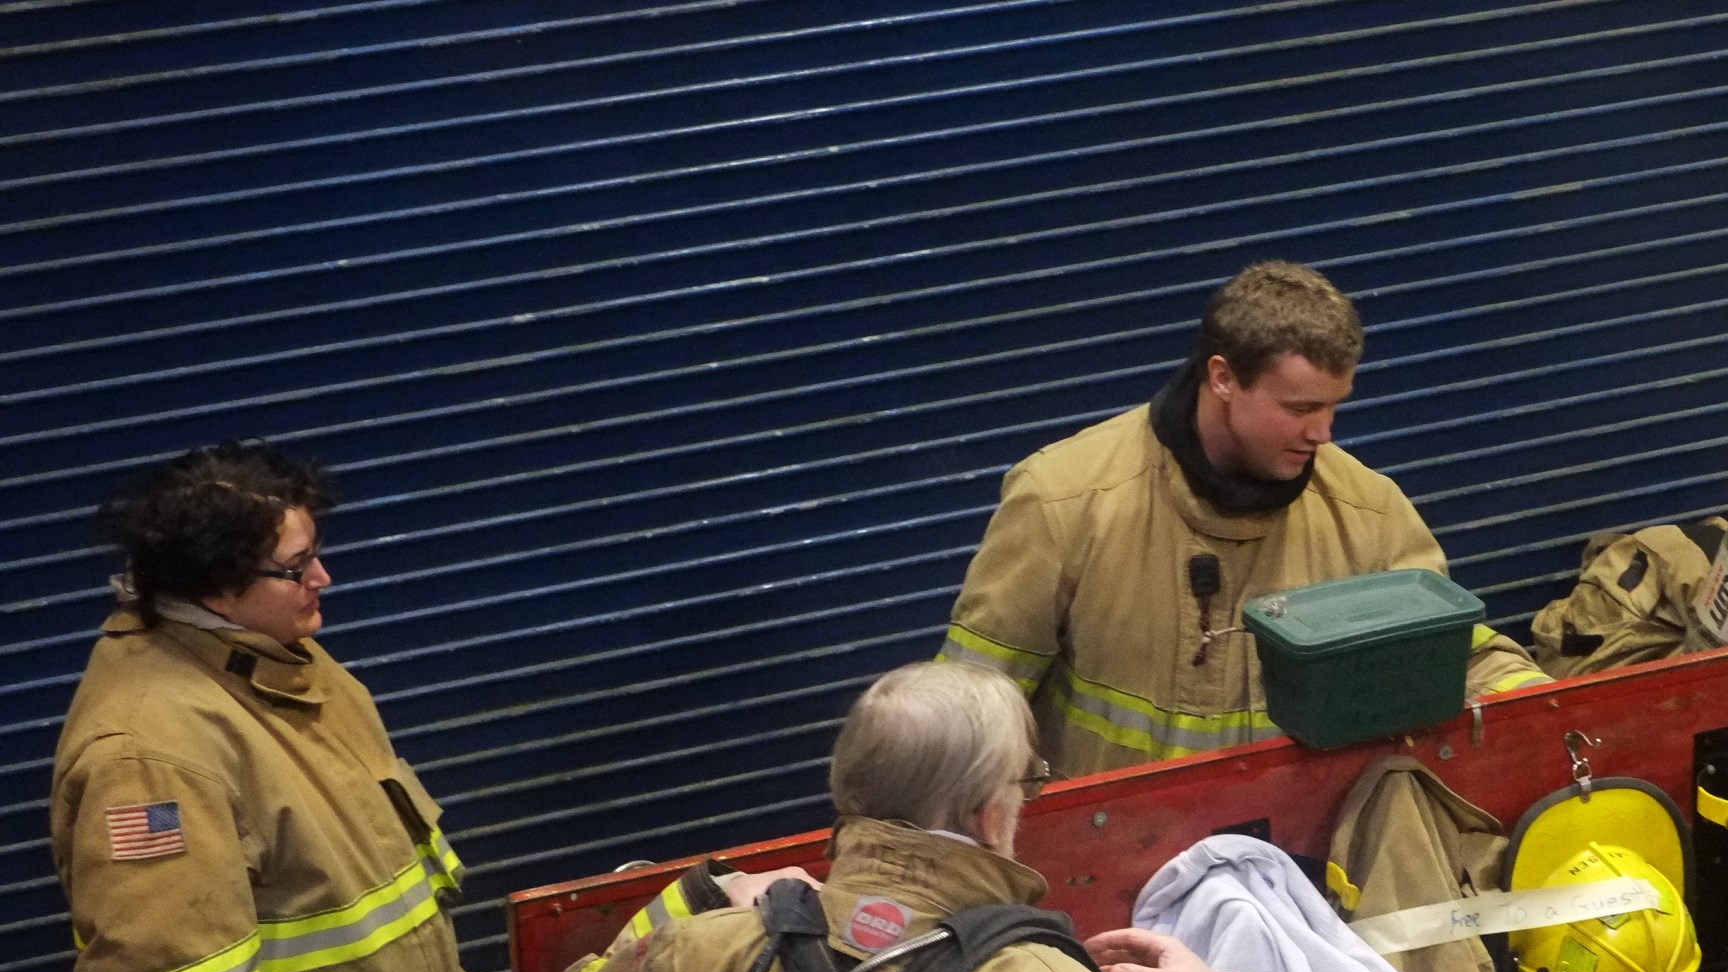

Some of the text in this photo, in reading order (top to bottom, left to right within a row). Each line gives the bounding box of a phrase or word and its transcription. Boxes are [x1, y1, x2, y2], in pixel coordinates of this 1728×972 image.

[1449, 909, 1480, 935] Free
[1545, 906, 1559, 919] a
[1569, 887, 1645, 913] Guest
